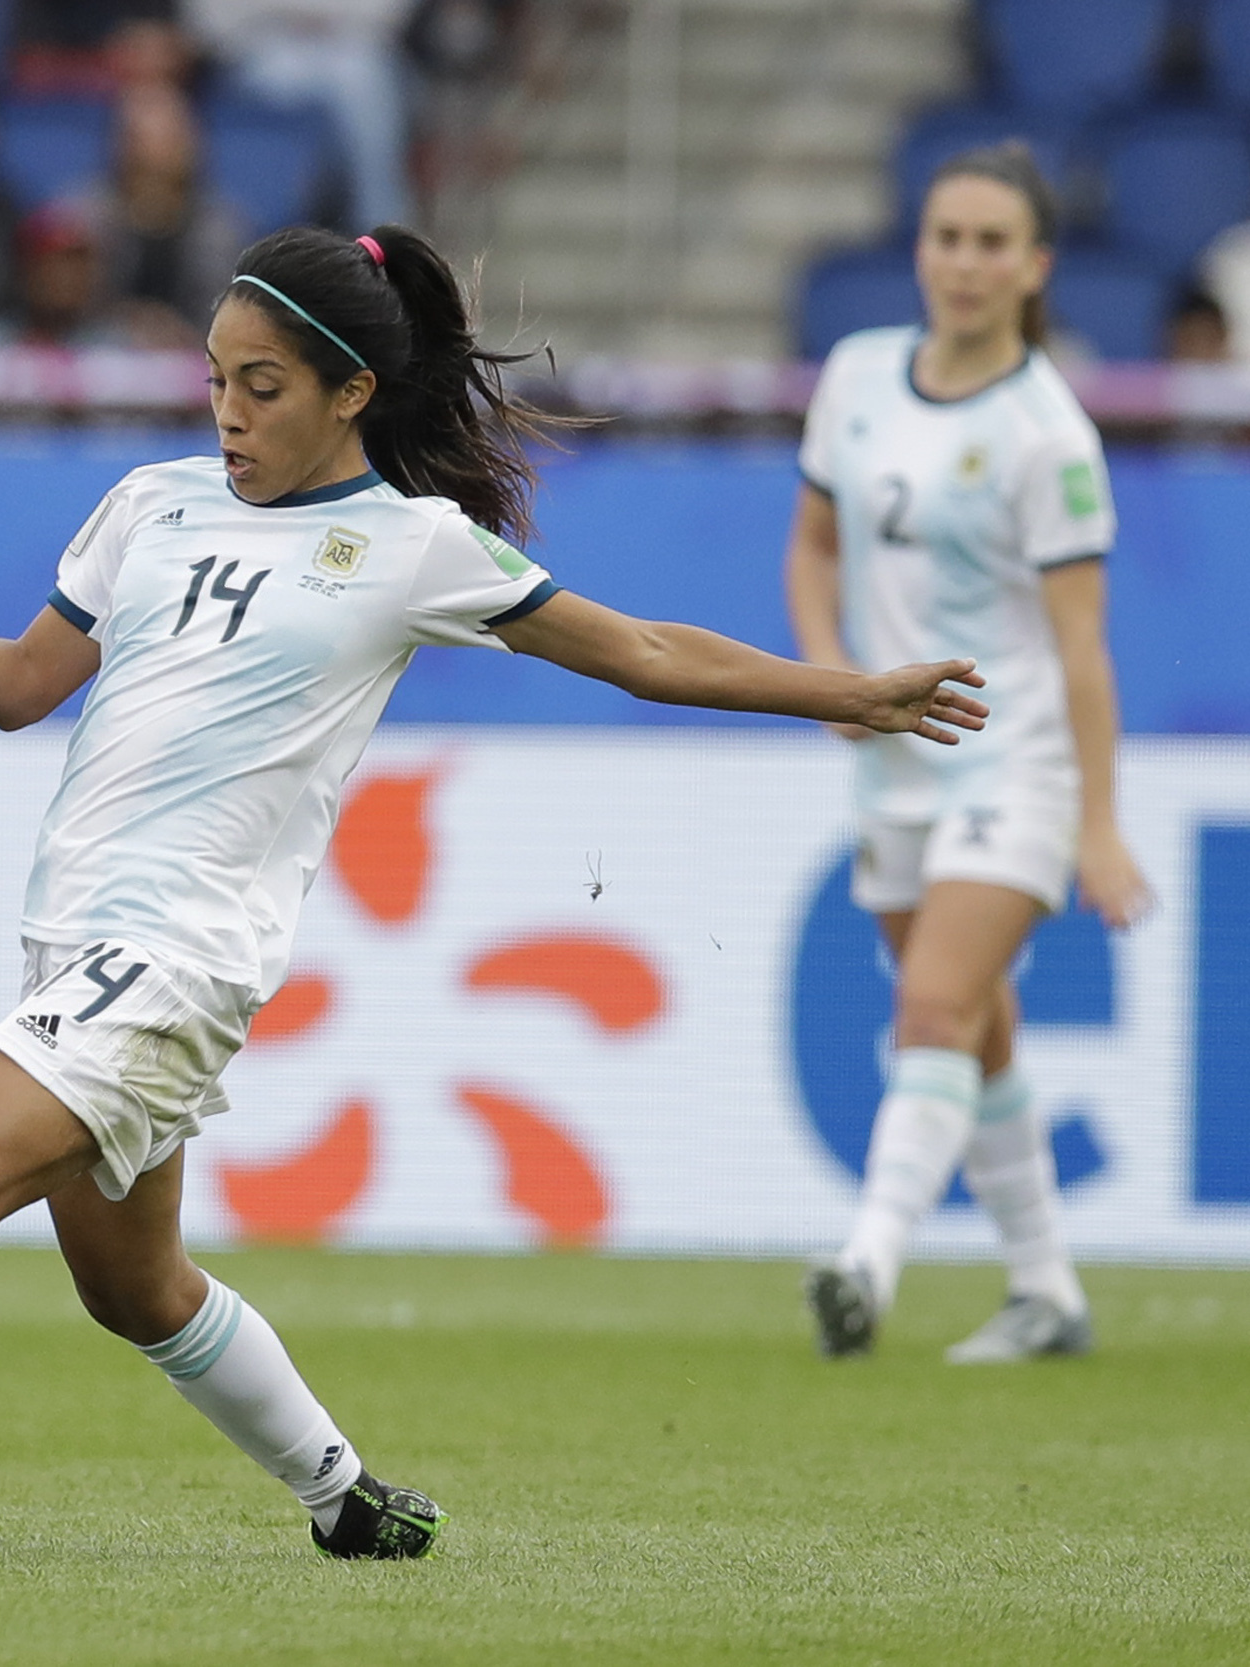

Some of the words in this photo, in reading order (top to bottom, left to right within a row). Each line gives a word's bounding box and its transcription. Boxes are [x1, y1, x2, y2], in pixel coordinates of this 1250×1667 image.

[878, 473, 917, 545] 2
[171, 554, 273, 643] 14
[34, 941, 150, 1024] 14
[15, 1015, 59, 1050] adidas
